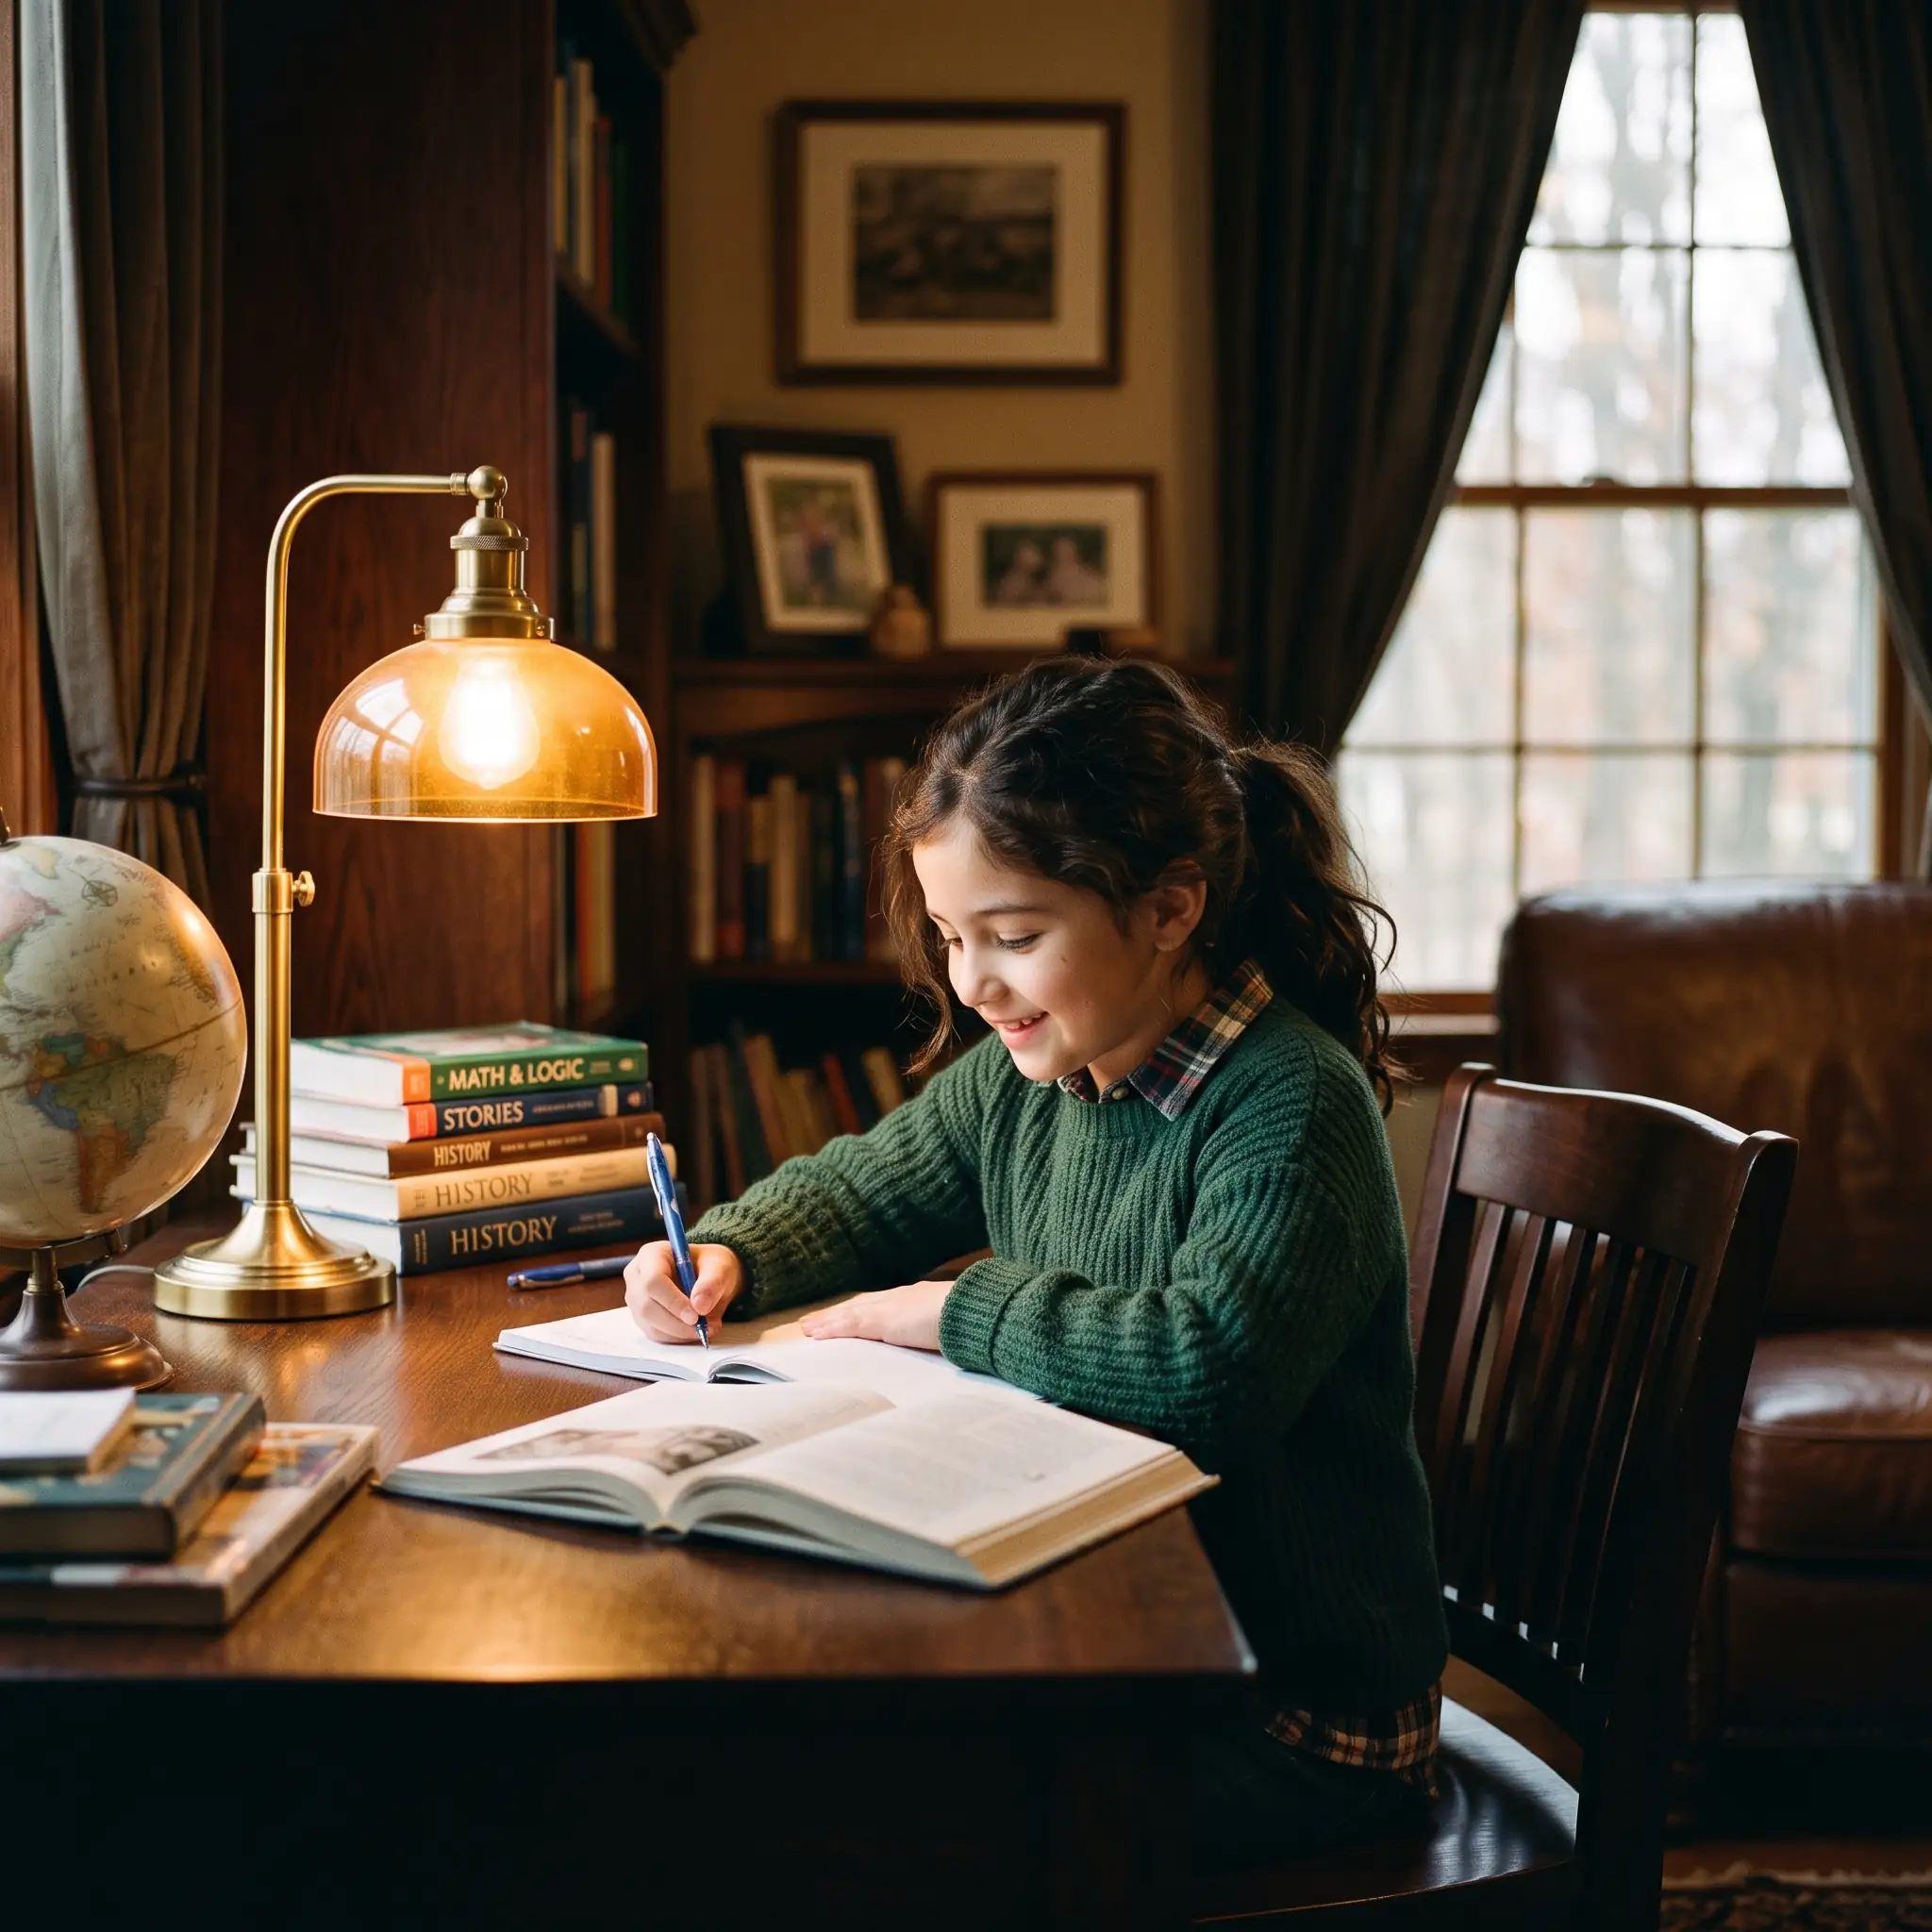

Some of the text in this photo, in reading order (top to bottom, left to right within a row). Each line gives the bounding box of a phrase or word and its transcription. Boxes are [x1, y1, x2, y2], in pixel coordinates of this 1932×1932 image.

[448, 1064, 506, 1091] MATH
[509, 1063, 525, 1086] &
[526, 1058, 585, 1084] LOGIC
[443, 1100, 525, 1131] STORIES
[433, 1140, 491, 1168] HISTORY
[435, 1173, 532, 1208] HISTORY
[451, 1214, 558, 1256] HISTORY
